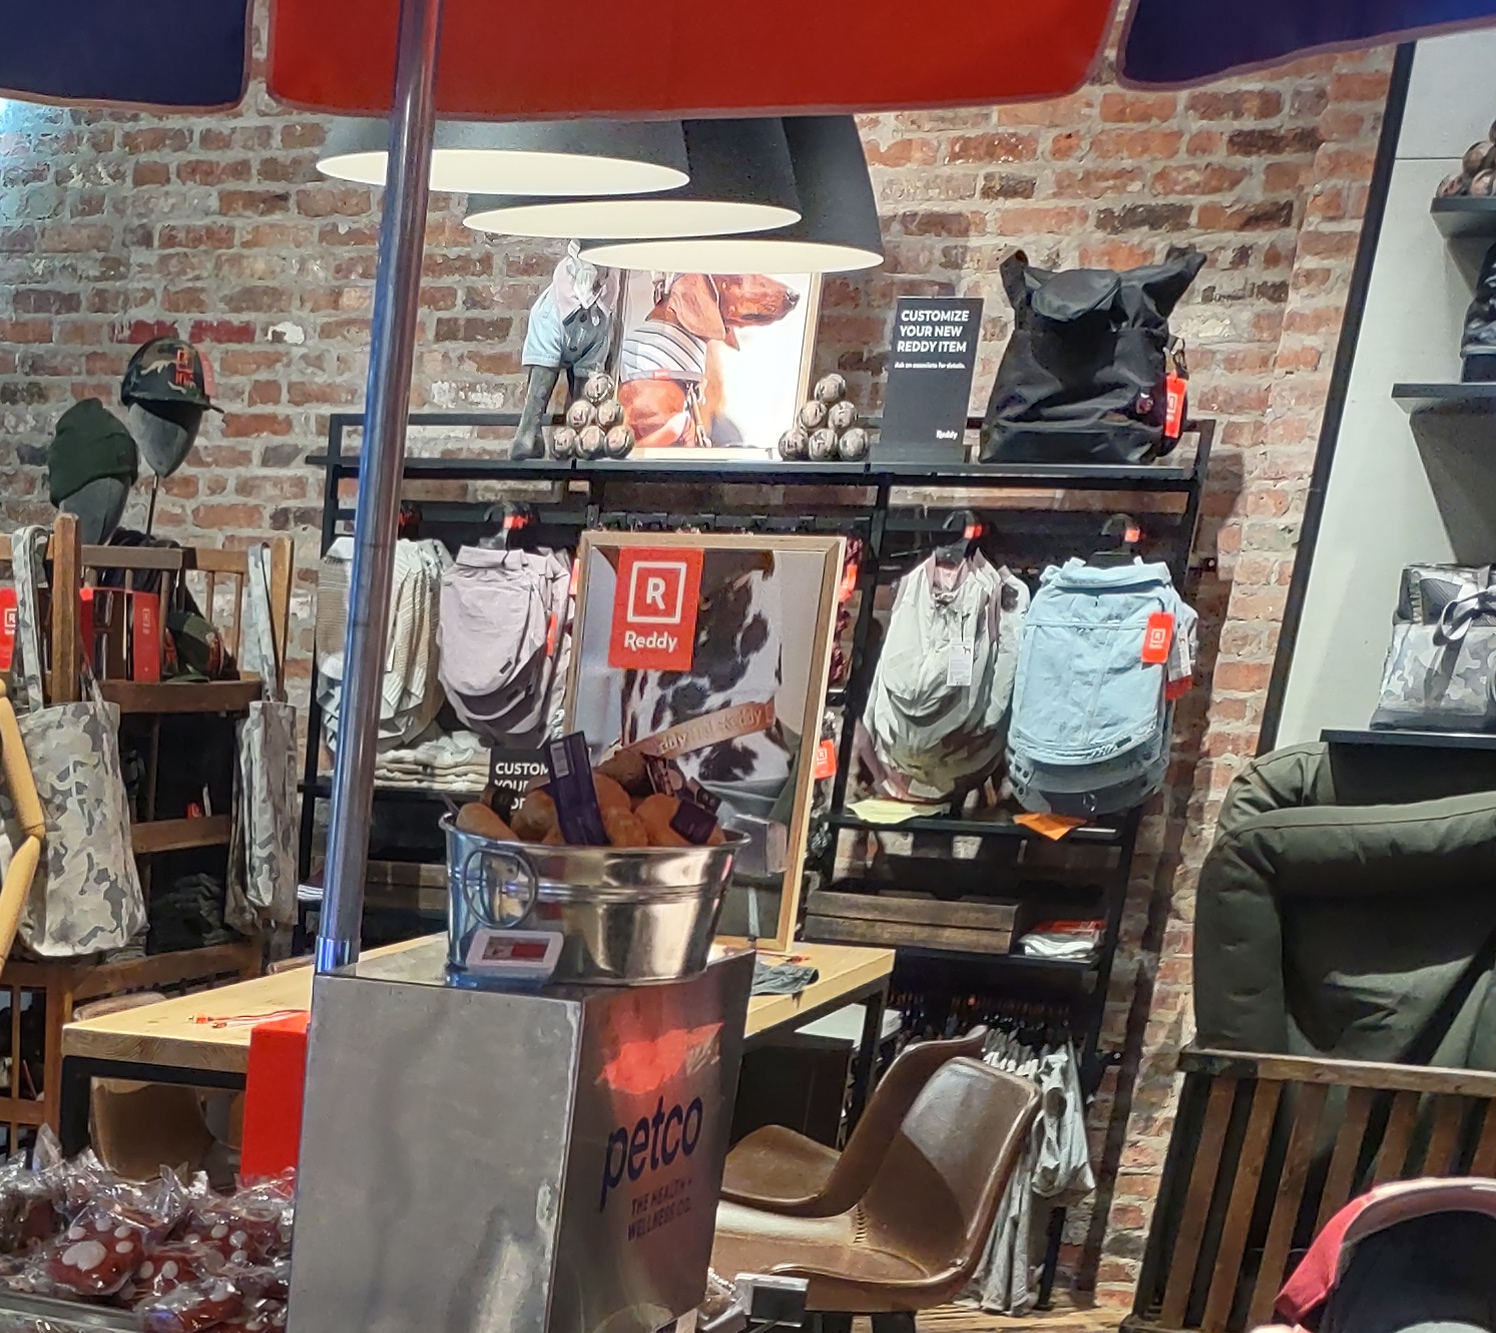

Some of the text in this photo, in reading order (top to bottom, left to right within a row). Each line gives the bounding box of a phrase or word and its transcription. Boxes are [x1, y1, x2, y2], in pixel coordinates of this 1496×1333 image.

[901, 310, 970, 322] CUSTOMIZE
[900, 325, 963, 337] YOUR NEW
[897, 341, 967, 352] REDDY ITEM
[646, 577, 666, 610] R
[624, 630, 678, 653] Reddy
[495, 762, 549, 776] CUSTOM
[600, 1095, 703, 1213] petco
[631, 1193, 649, 1217] THE
[651, 1178, 686, 1206] HEALTH
[628, 1203, 676, 1241] WELLNESS
